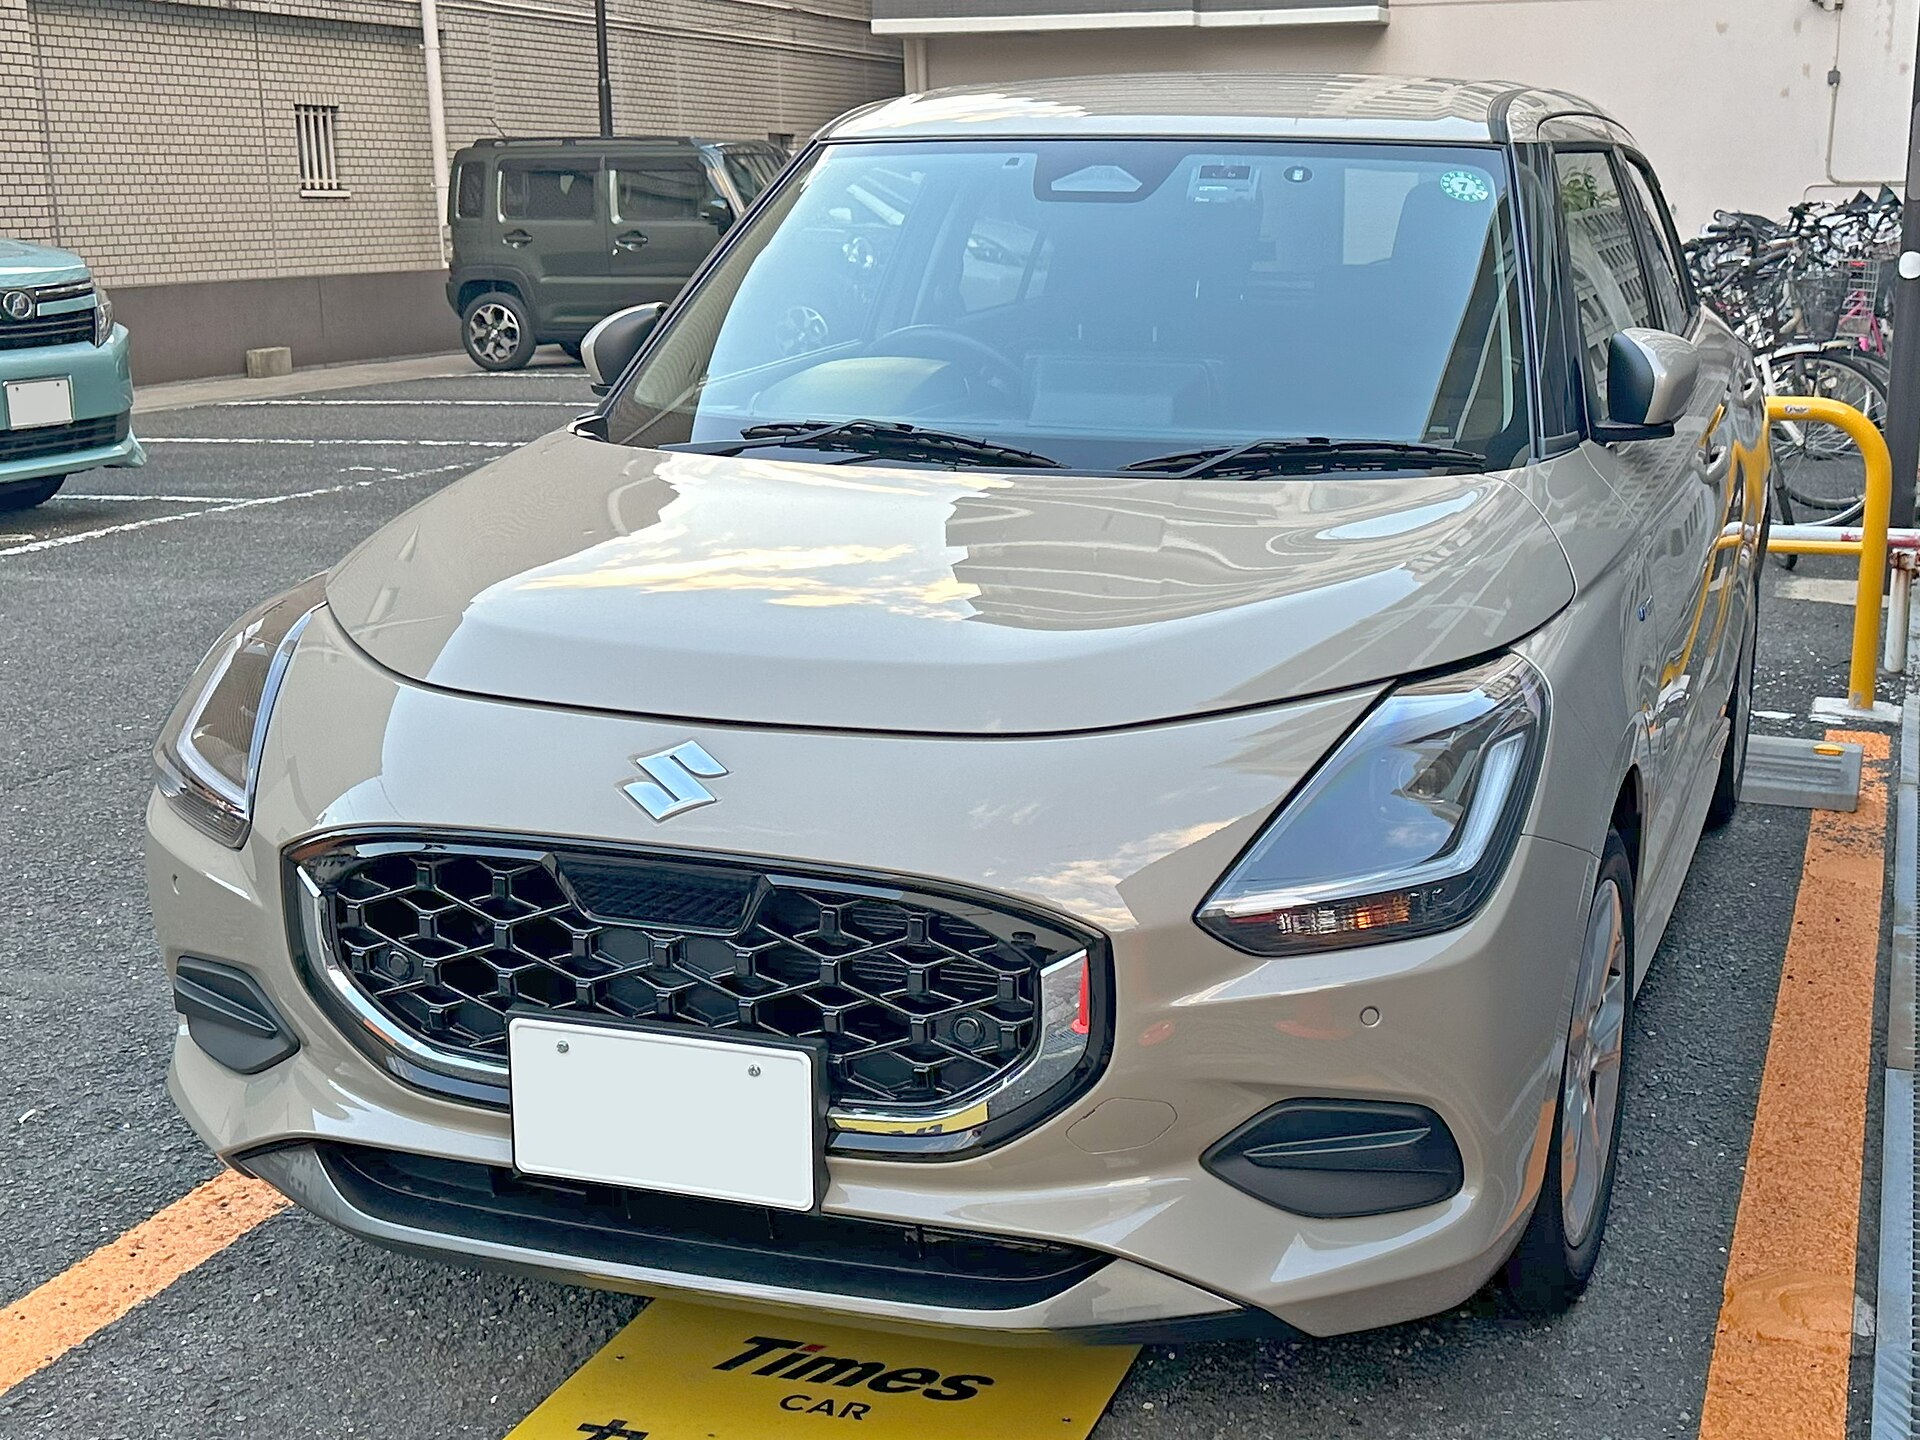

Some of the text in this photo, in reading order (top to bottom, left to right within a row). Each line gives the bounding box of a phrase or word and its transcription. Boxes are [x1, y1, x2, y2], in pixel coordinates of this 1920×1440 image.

[1458, 181, 1468, 191] 7
[712, 1336, 995, 1401] Times
[779, 1394, 872, 1420] CAR
